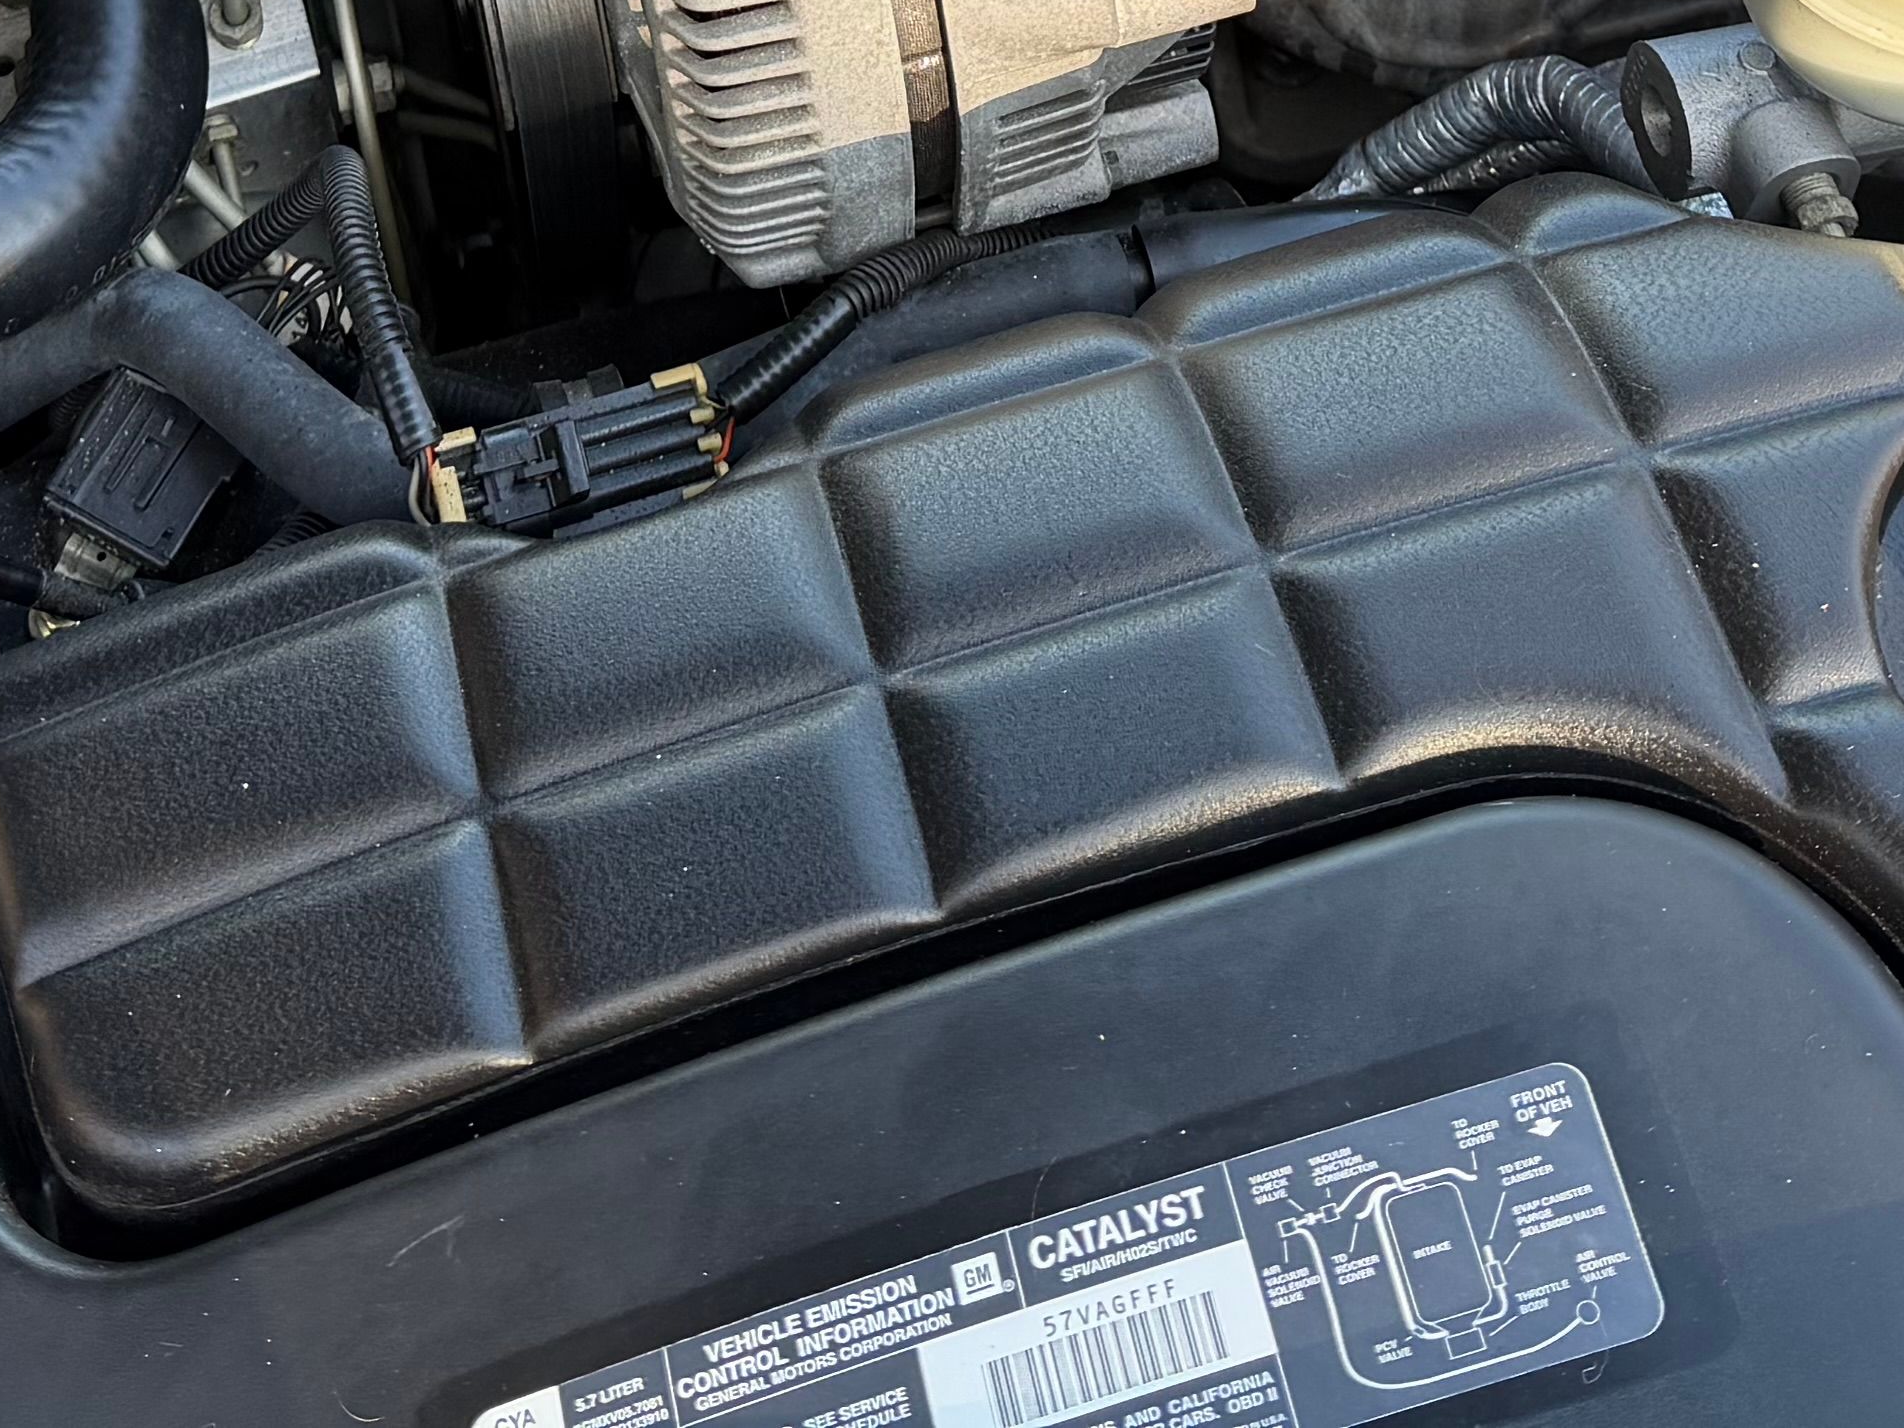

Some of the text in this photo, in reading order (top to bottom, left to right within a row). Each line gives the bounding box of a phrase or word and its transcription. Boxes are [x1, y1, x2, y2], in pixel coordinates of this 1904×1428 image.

[1510, 1079, 1567, 1109] FRONT
[1515, 1095, 1574, 1123] OF VEH
[1451, 1118, 1468, 1130] TO
[1454, 1119, 1501, 1140] ROCKER
[1458, 1130, 1496, 1150] COVER
[1313, 1160, 1380, 1188] CONNECTOR
[1497, 1154, 1544, 1175] TO EVAP
[1501, 1164, 1555, 1187] CANISTER
[1511, 1183, 1594, 1216] EVAP CANISTER
[1029, 1185, 1205, 1270] CATALYST
[1519, 1204, 1609, 1238] SOLENOID VALVE
[1330, 1253, 1349, 1265] TO
[1412, 1240, 1454, 1260] INTAKE
[1575, 1249, 1597, 1262] AIR
[1334, 1253, 1381, 1275] ROCKER
[1578, 1251, 1632, 1274] CONTROL
[1581, 1265, 1619, 1284] VALVE
[963, 1262, 993, 1288] GM
[1267, 1274, 1322, 1299] SOLENOID
[1337, 1266, 1377, 1286] COVER
[1515, 1278, 1572, 1303] THROTTLE
[702, 1274, 918, 1363] VEHICLE EMISSION
[1043, 1278, 1177, 1338] 57VAGFFF
[1519, 1298, 1551, 1316] BODY
[677, 1287, 955, 1399] CONTROL INFORMATION
[1373, 1339, 1398, 1354] PCV
[695, 1312, 953, 1411] GENERAL MOTORS CORPORATION
[1377, 1346, 1415, 1365] VALVE
[597, 1376, 645, 1403] LITER
[1167, 1371, 1275, 1415] CALIFORNIA
[801, 1386, 910, 1428] SEE SERVICE
[1227, 1391, 1264, 1415] OBD
[1124, 1406, 1161, 1428] AND
